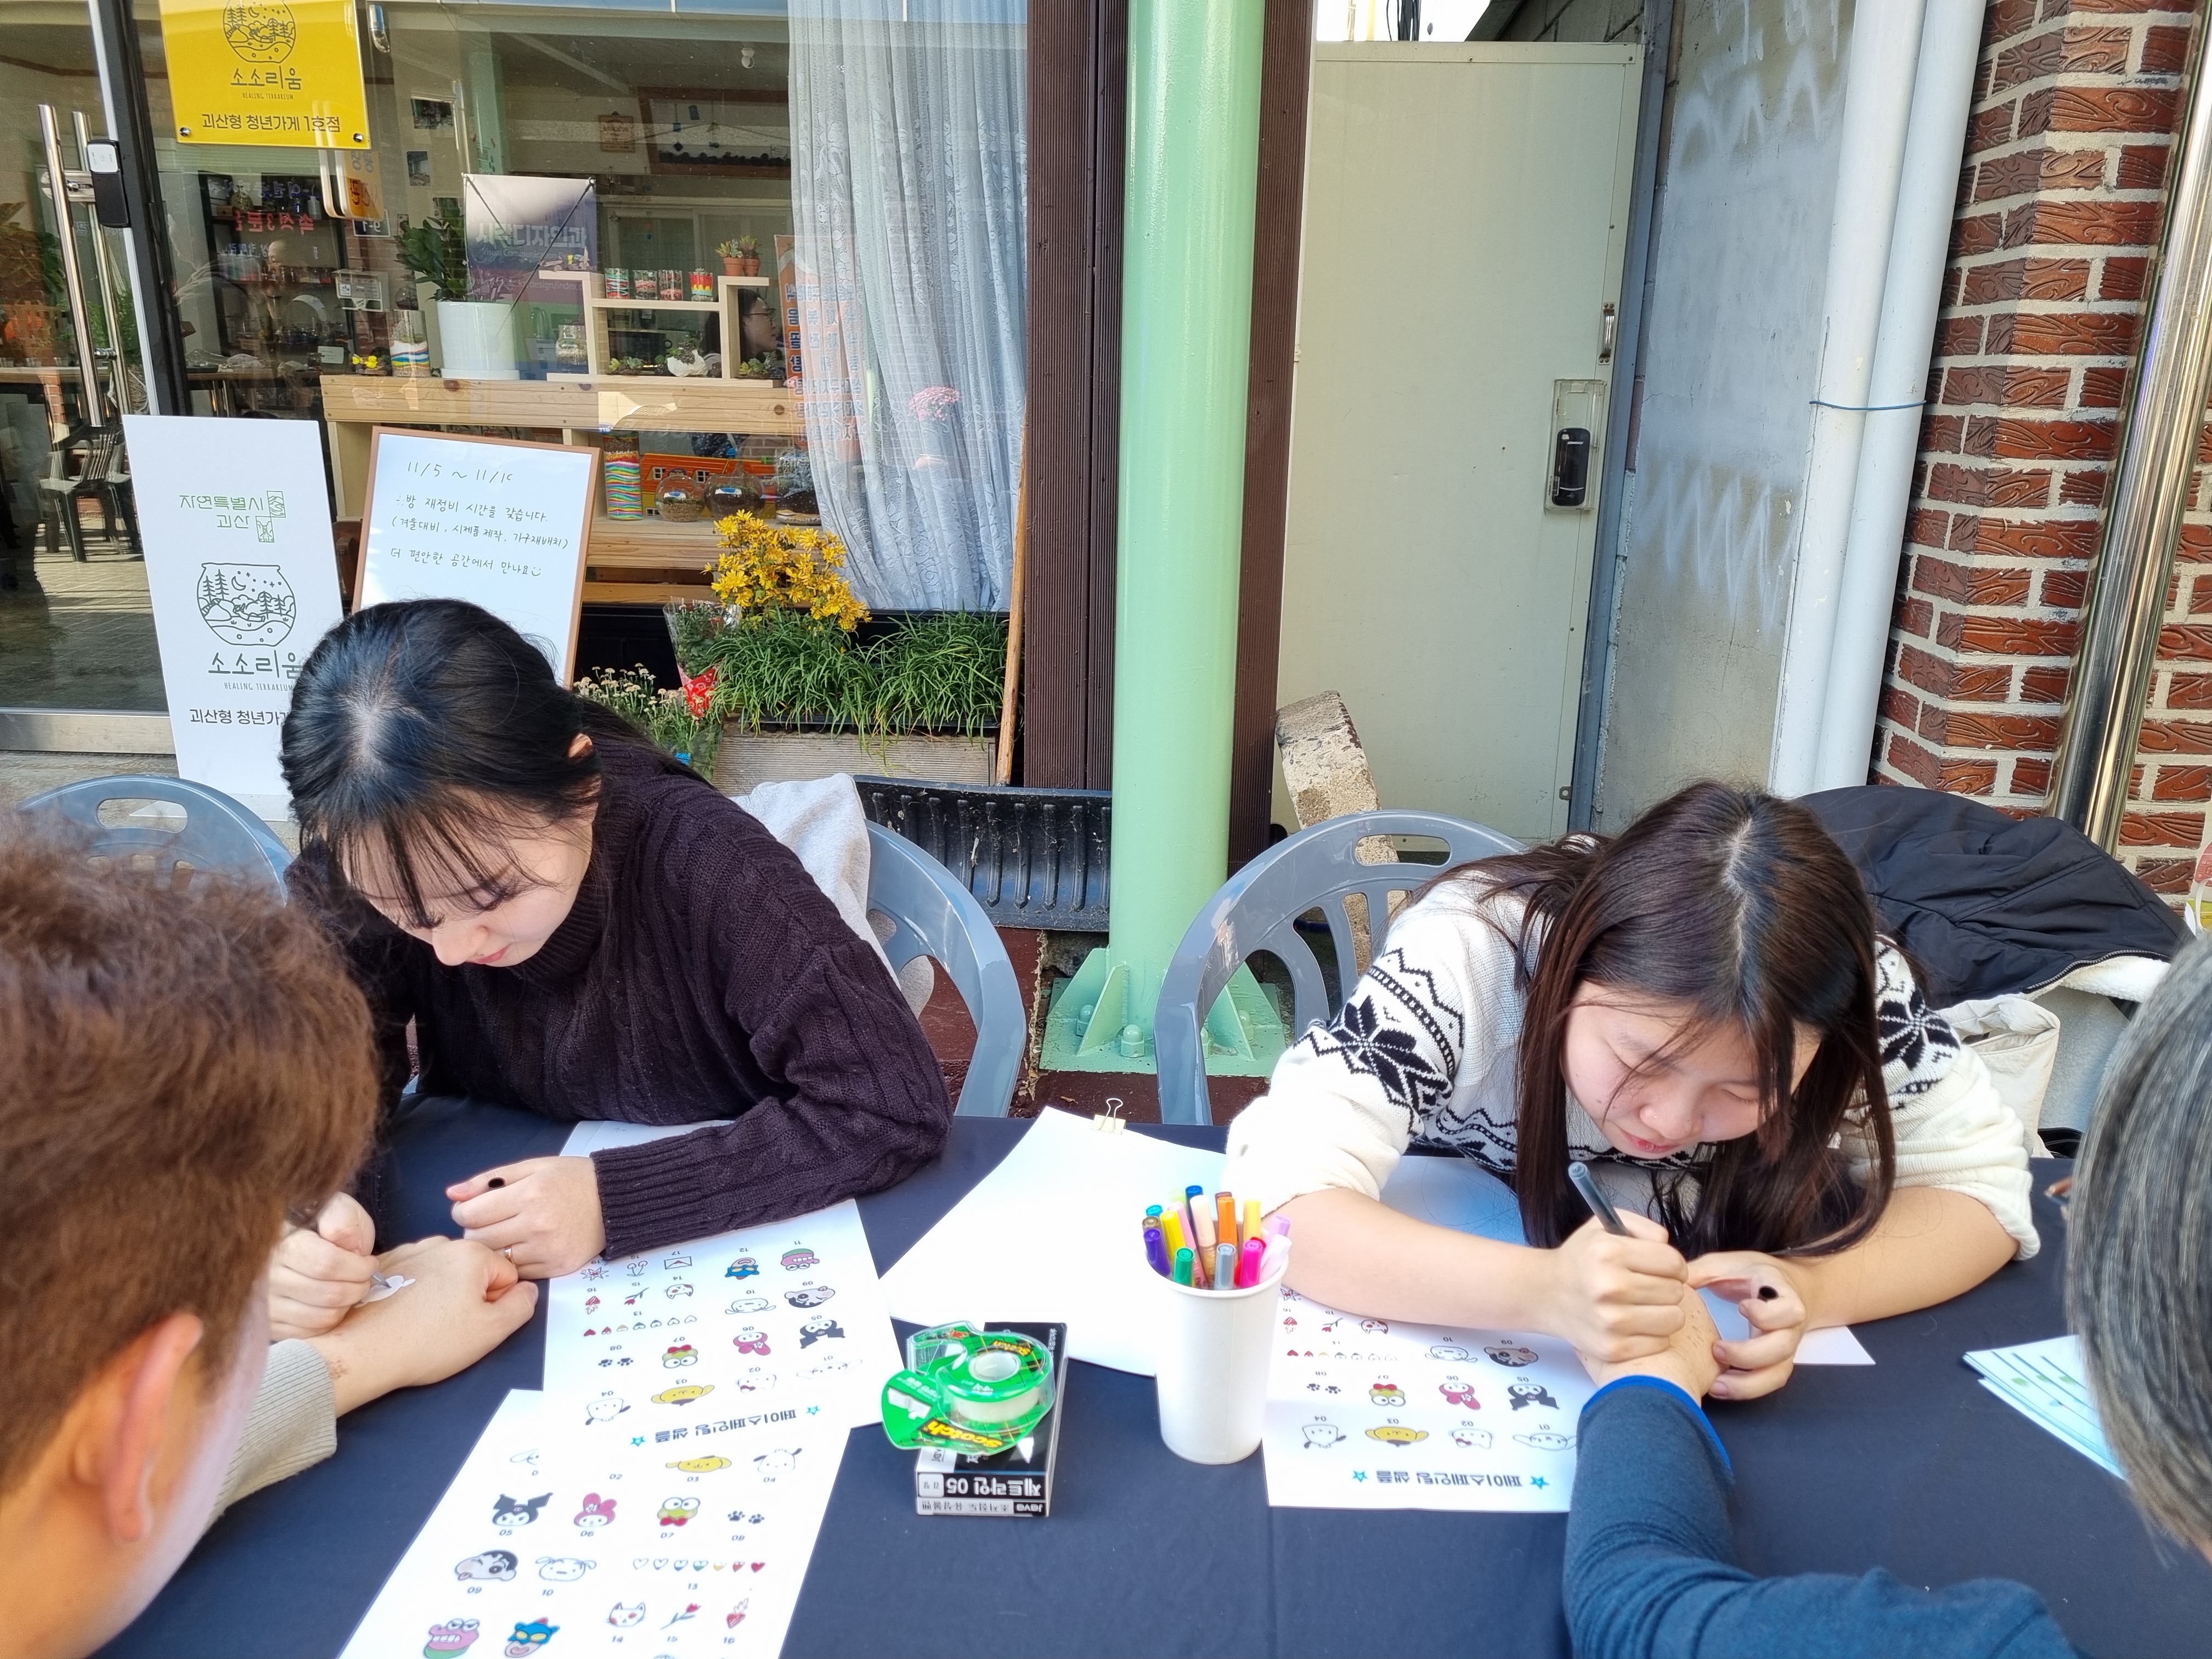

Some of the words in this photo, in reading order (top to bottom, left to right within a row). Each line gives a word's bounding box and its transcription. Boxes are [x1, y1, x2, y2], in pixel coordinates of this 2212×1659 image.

[230, 65, 302, 90] 소소리움
[201, 114, 242, 129] 괴산형
[246, 115, 301, 132] 청년가게
[303, 116, 341, 133] 1호점
[408, 461, 442, 477] 11/5
[179, 495, 263, 511] 자연특별시
[425, 497, 459, 512] 재정비
[466, 503, 496, 518] 시간을
[217, 515, 250, 529] 괴산
[391, 548, 400, 558] 더
[409, 549, 443, 565] 편안한
[450, 553, 494, 570] 공간에서
[500, 561, 528, 575] 만나요
[208, 649, 302, 679] 소소리움
[224, 682, 254, 691] HEALING
[255, 682, 293, 692] TERRARIUM
[189, 709, 233, 724] 괴산형
[236, 709, 290, 726] 청년가
[696, 1409, 797, 1436] 페이스페인팅
[655, 1427, 688, 1443] 샘플
[927, 1421, 1003, 1448] Scotch
[946, 1477, 968, 1494] 05
[1376, 1470, 1410, 1484] 샘플
[1417, 1471, 1523, 1487] 페이스페인팅
[974, 1477, 1042, 1497] 제트라인
[1017, 1503, 1043, 1512] Java
